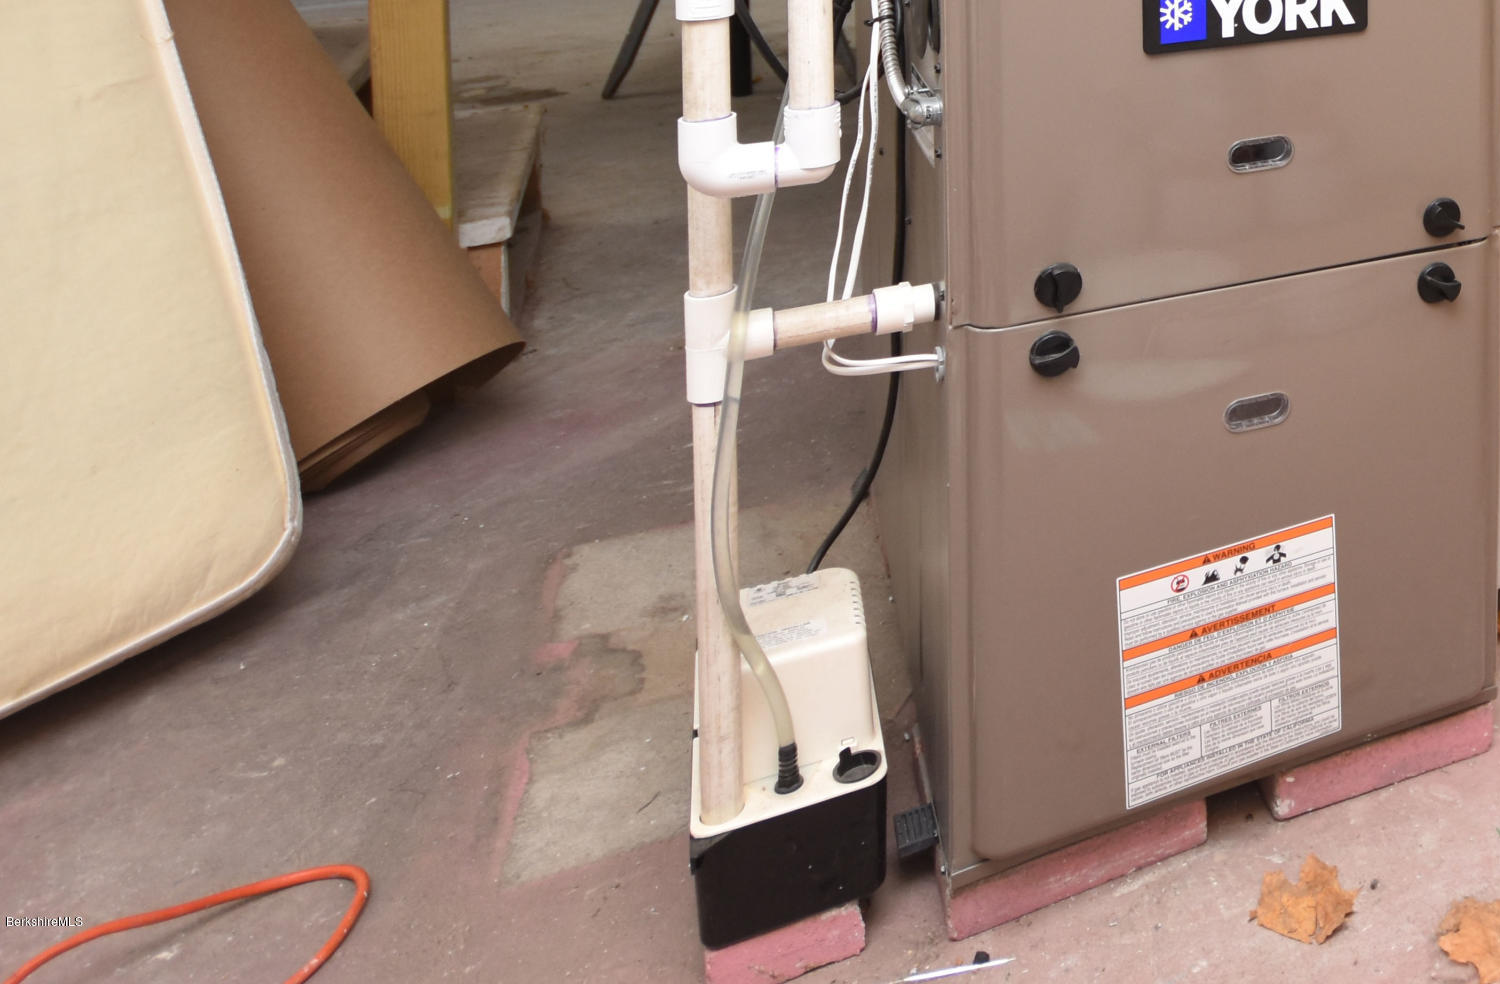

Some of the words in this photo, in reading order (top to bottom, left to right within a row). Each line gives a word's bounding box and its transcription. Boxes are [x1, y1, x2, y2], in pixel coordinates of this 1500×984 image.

[1212, 542, 1255, 561] WARNING
[1182, 585, 1215, 599] EXPLOSION
[1228, 569, 1268, 585] ASPHYXIATION
[1269, 561, 1292, 572] HAZARD
[1200, 604, 1275, 635] AVERTISSEMENT
[1168, 641, 1192, 652] DANGER
[1208, 652, 1271, 679] ADVERTENCIA
[1136, 740, 1165, 753] EXTERNAL
[1168, 731, 1191, 742] FILTERS
[1156, 770, 1168, 778] FOR
[1170, 756, 1204, 773] APPLIANCES
[1206, 745, 1236, 759] INSTALLED
[1256, 732, 1272, 741] STATE
[1282, 716, 1313, 731] CALIFORNIA
